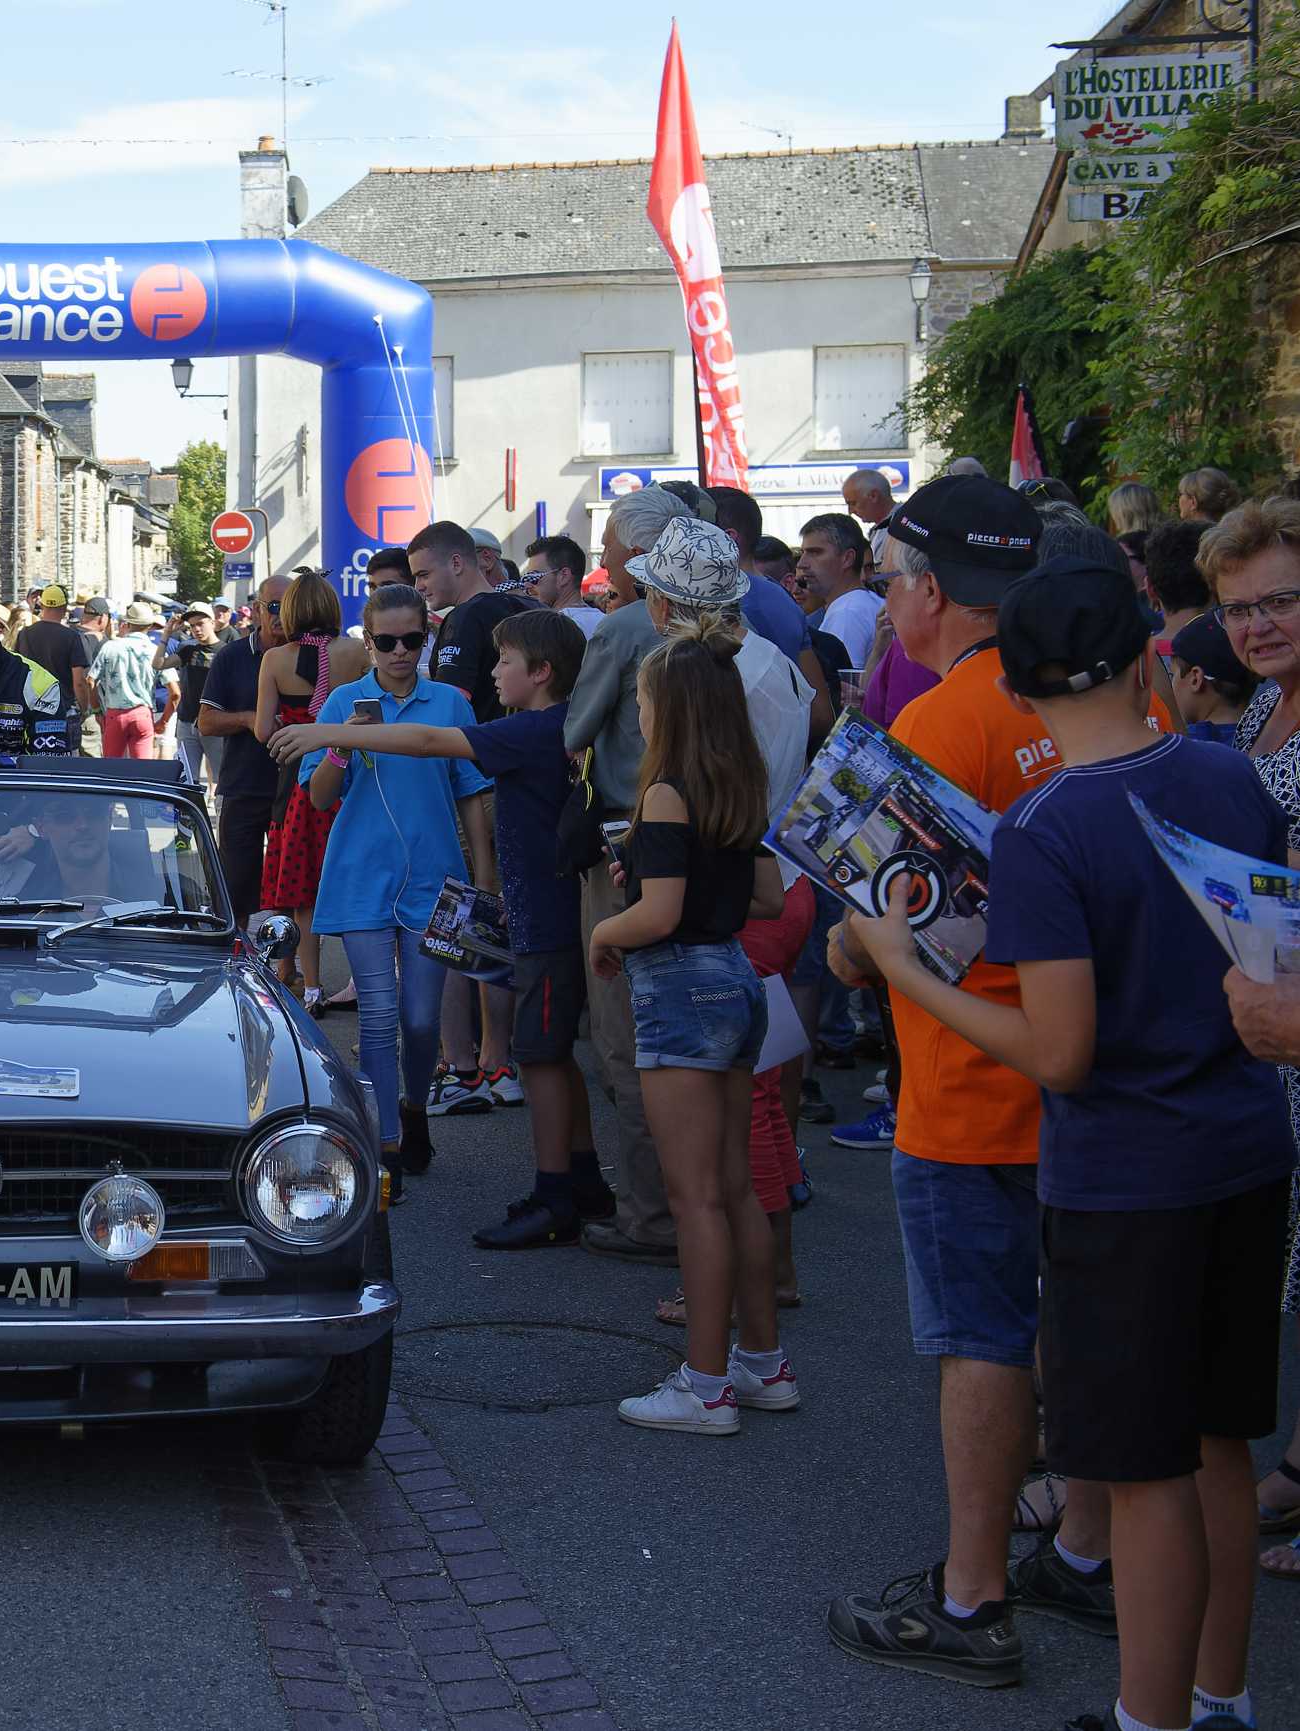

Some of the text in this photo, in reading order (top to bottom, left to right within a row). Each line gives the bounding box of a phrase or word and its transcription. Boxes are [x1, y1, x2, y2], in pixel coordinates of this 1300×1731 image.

[1064, 92, 1217, 120] DU VILLAG
[1074, 161, 1139, 180] CAVE
